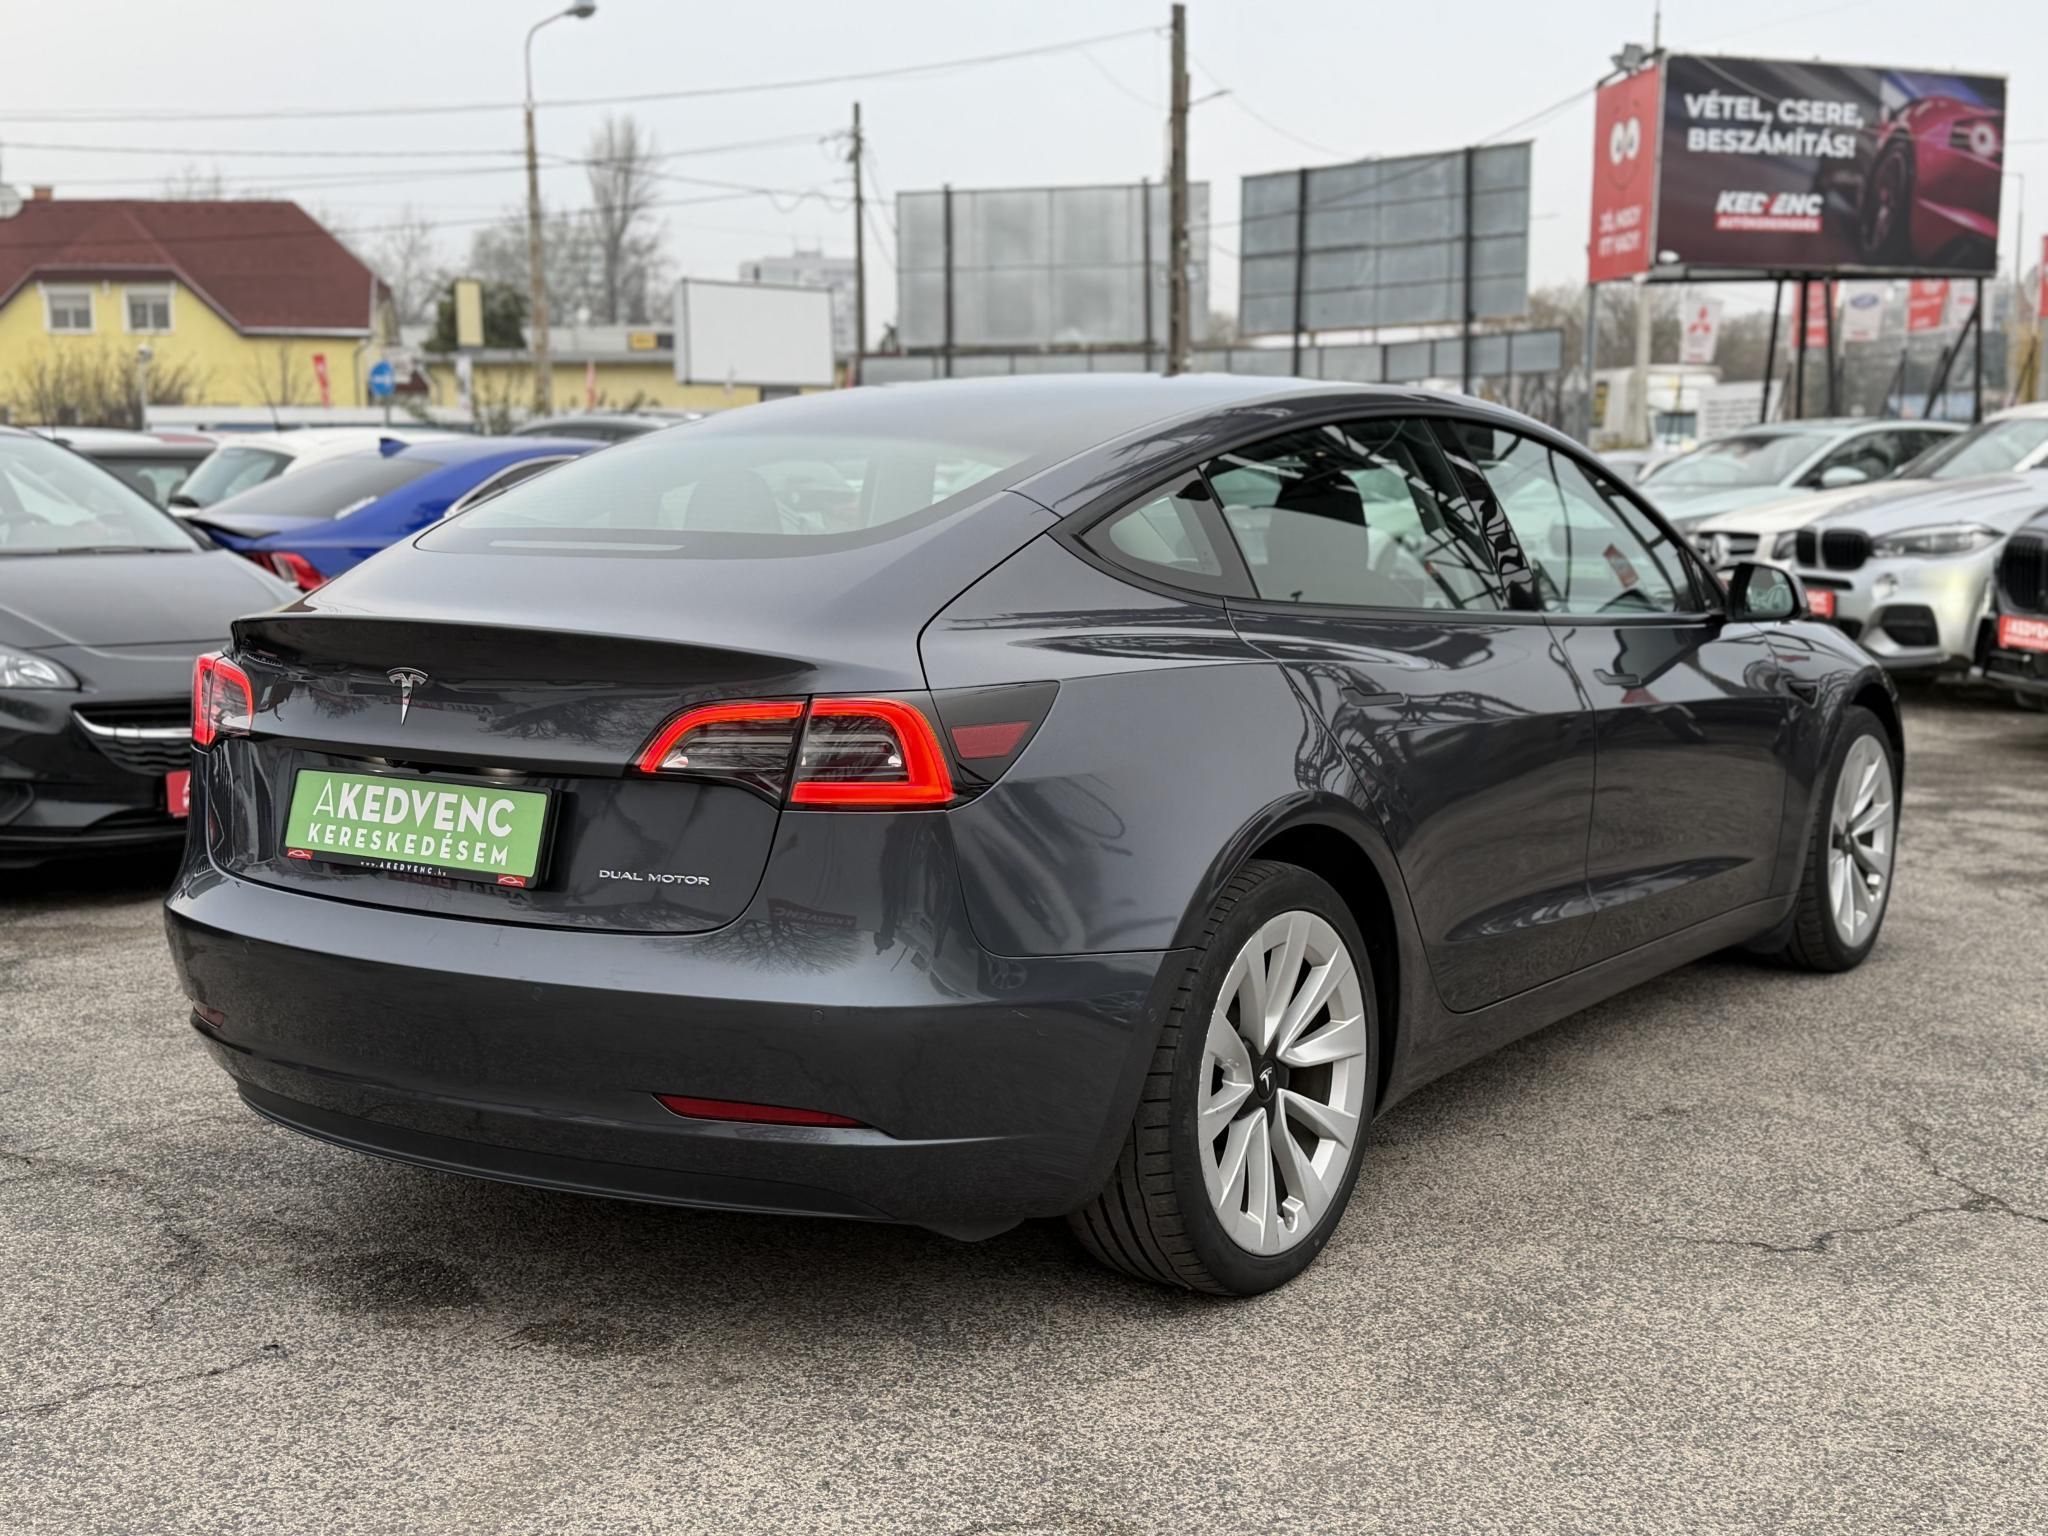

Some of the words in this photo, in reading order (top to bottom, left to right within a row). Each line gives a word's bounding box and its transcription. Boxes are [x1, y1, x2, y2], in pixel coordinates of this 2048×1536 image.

[1685, 89, 1773, 123] VÉTEL,
[1777, 98, 1864, 129] CSERE,
[1688, 125, 1857, 158] BESZÁMÍTÁS!
[312, 777, 515, 838] AKEDVENC
[307, 822, 509, 867] KERESKEDÉSEM
[598, 869, 644, 882] DUAL
[648, 873, 711, 886] MOTOR
